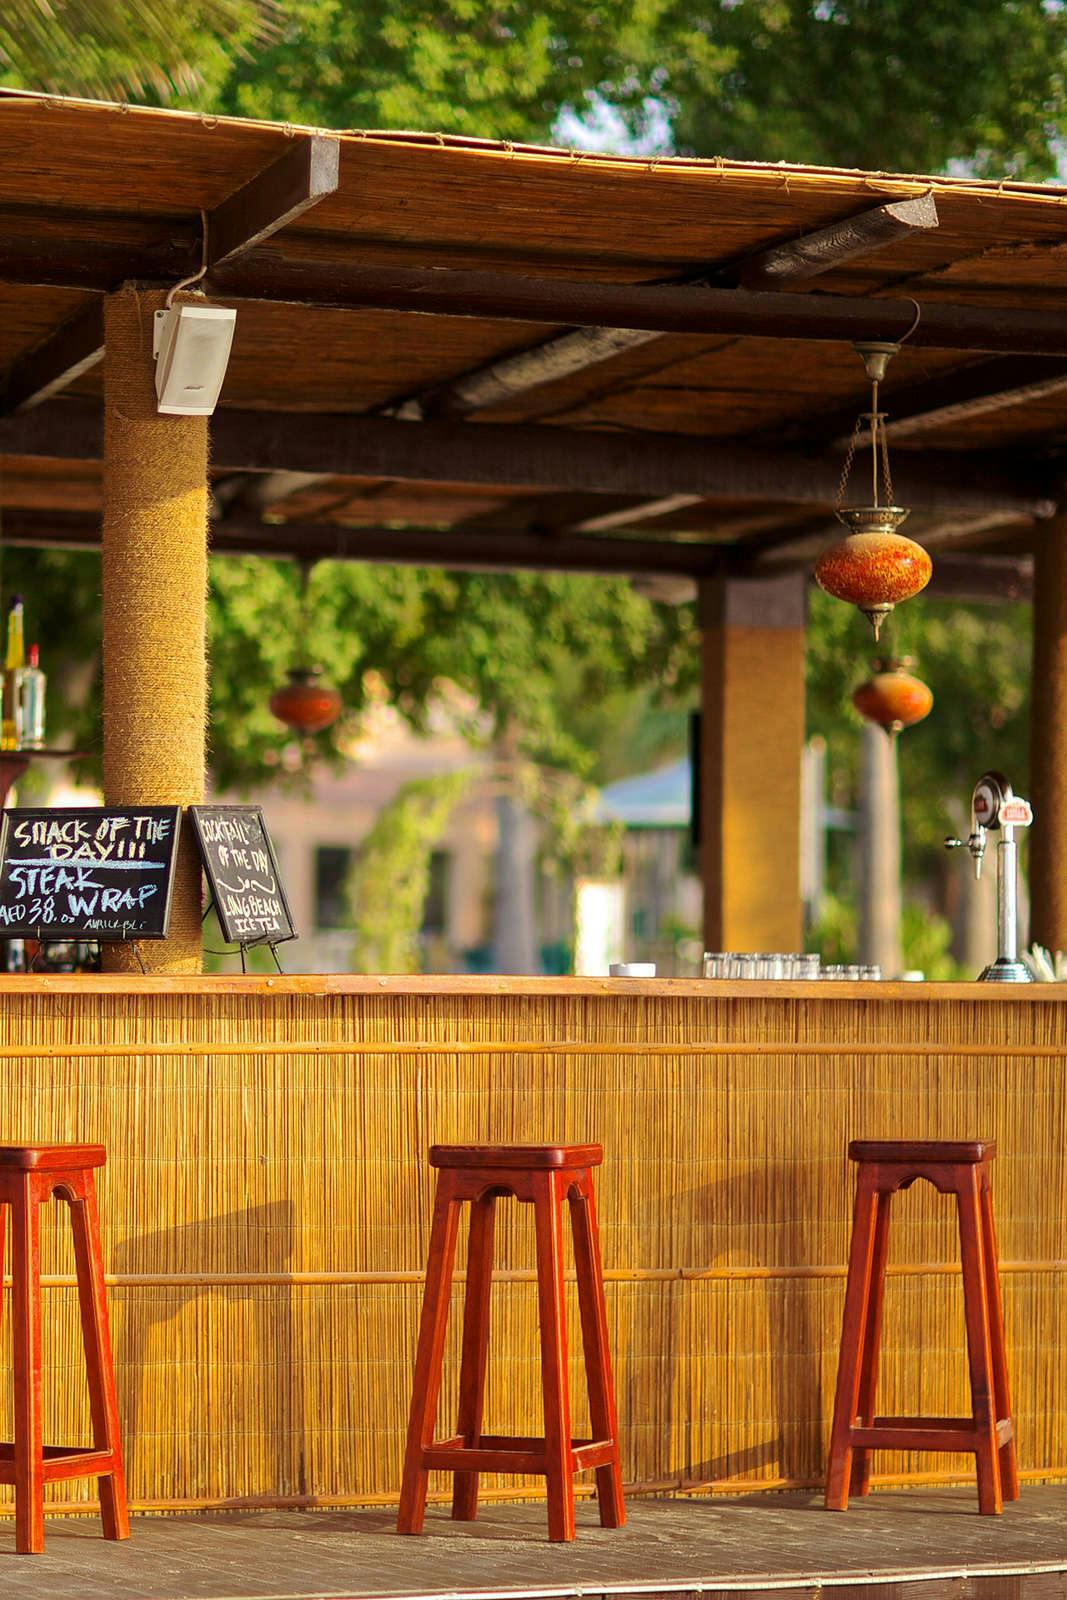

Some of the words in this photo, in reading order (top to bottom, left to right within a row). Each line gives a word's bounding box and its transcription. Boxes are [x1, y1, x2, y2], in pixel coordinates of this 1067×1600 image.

[14, 819, 92, 847] SNACK
[95, 817, 130, 842] OF
[133, 816, 171, 844] THE
[217, 844, 229, 869] OF
[230, 848, 252, 870] THE
[251, 847, 270, 876] DAY
[8, 865, 104, 899] STEAK
[0, 904, 26, 926] AED
[67, 884, 158, 917] WRAP
[221, 894, 249, 918] LONG
[248, 895, 282, 917] BEACH
[234, 917, 257, 933] ICE
[257, 917, 280, 931] TEA
